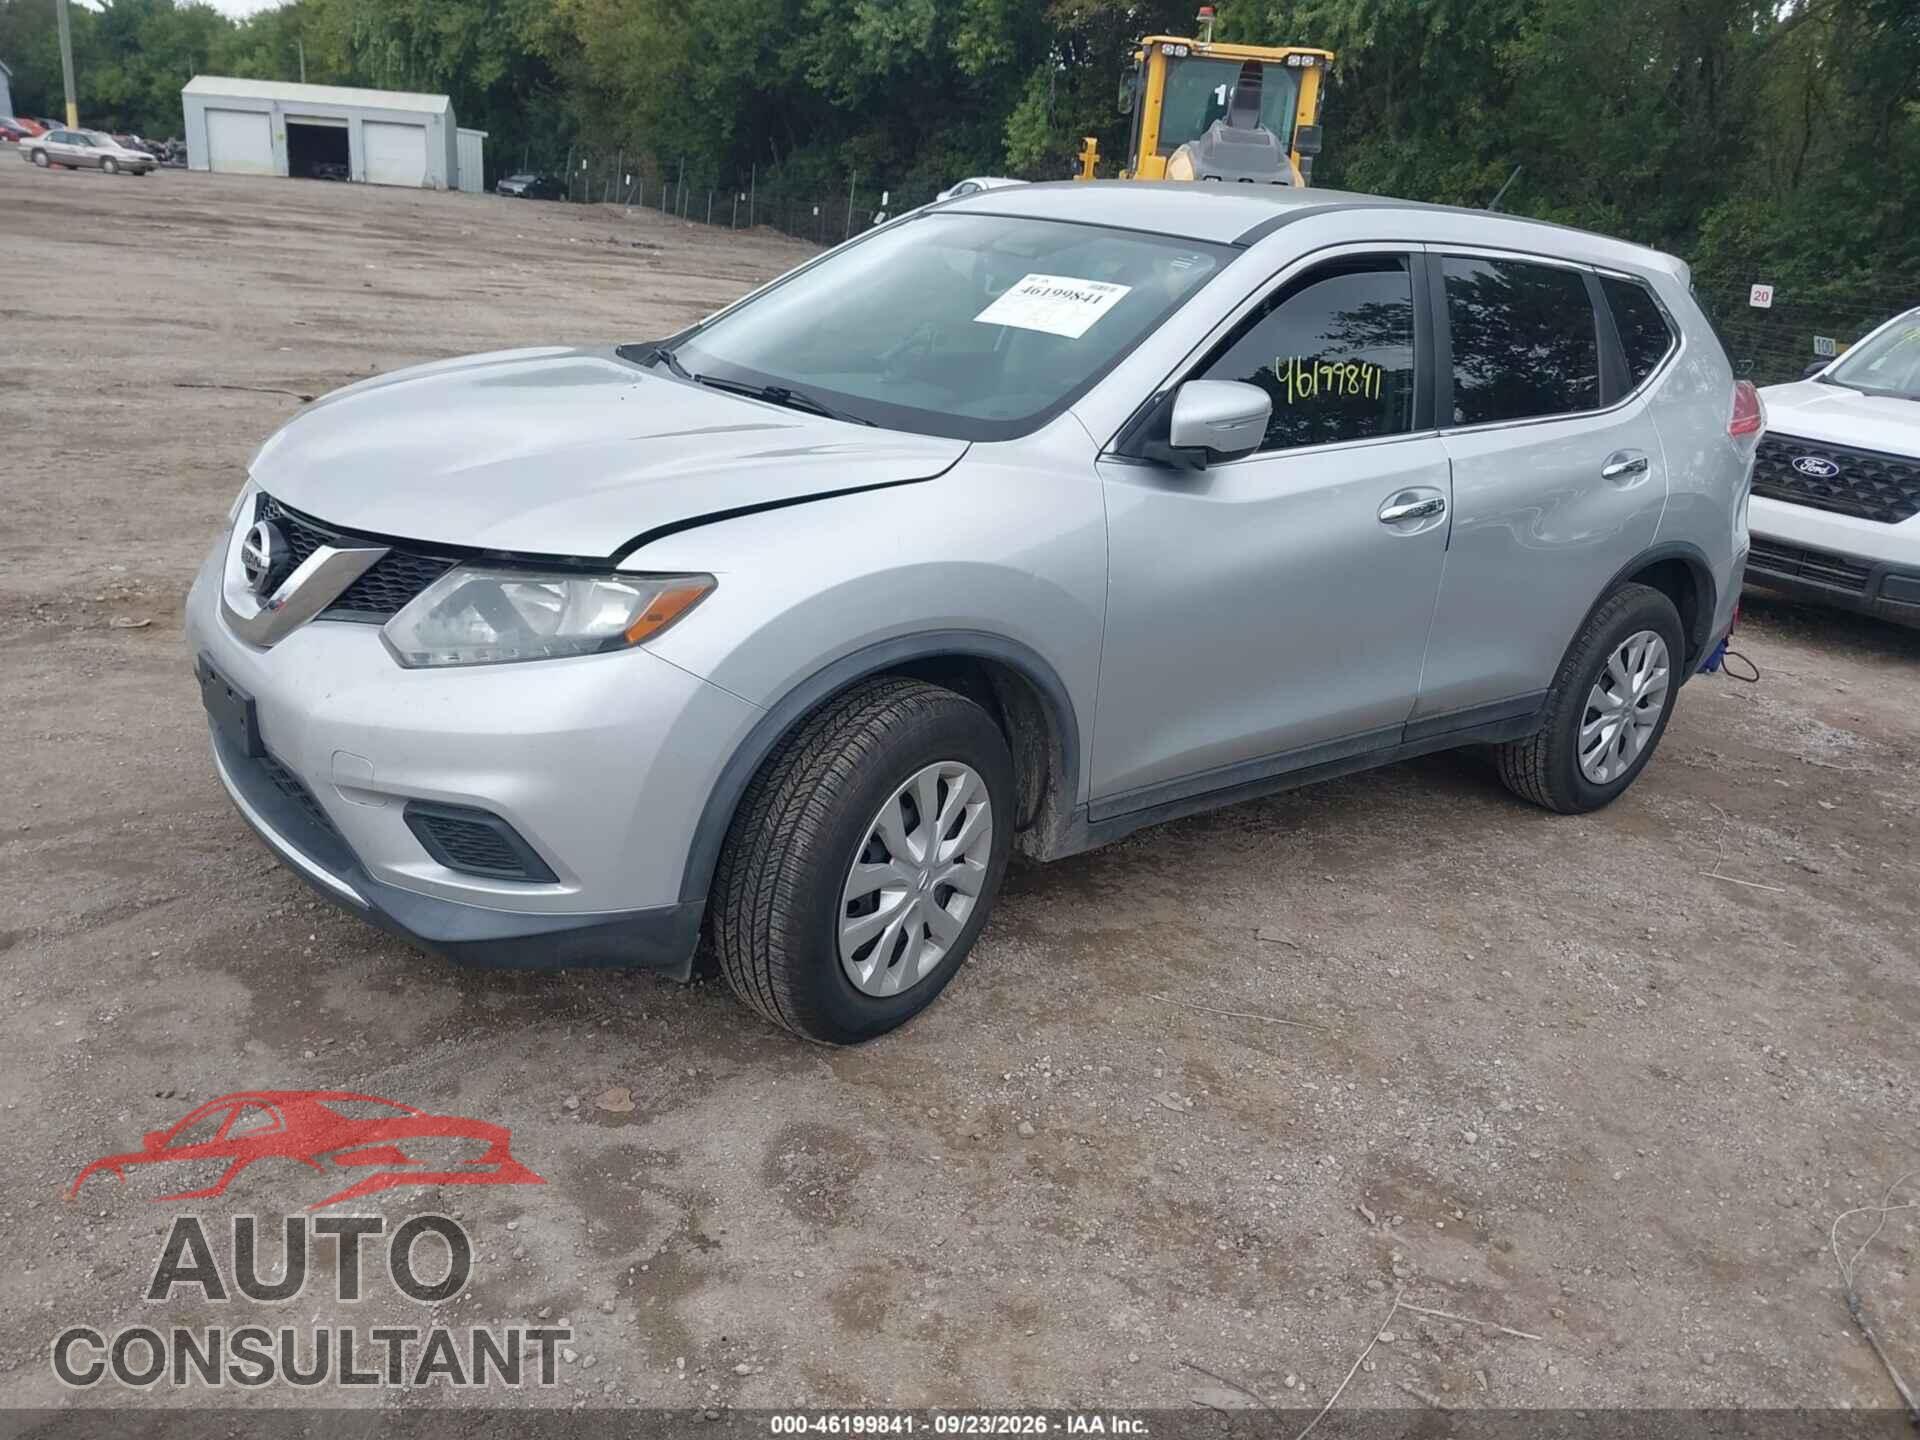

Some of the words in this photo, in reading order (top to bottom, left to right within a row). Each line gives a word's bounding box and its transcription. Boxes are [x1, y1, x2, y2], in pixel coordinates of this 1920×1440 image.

[1214, 84, 1235, 106] 1
[1021, 285, 1104, 305] 46199841
[1753, 290, 1769, 302] 20
[1275, 355, 1381, 404] 46199841
[1800, 458, 1830, 475] Ford
